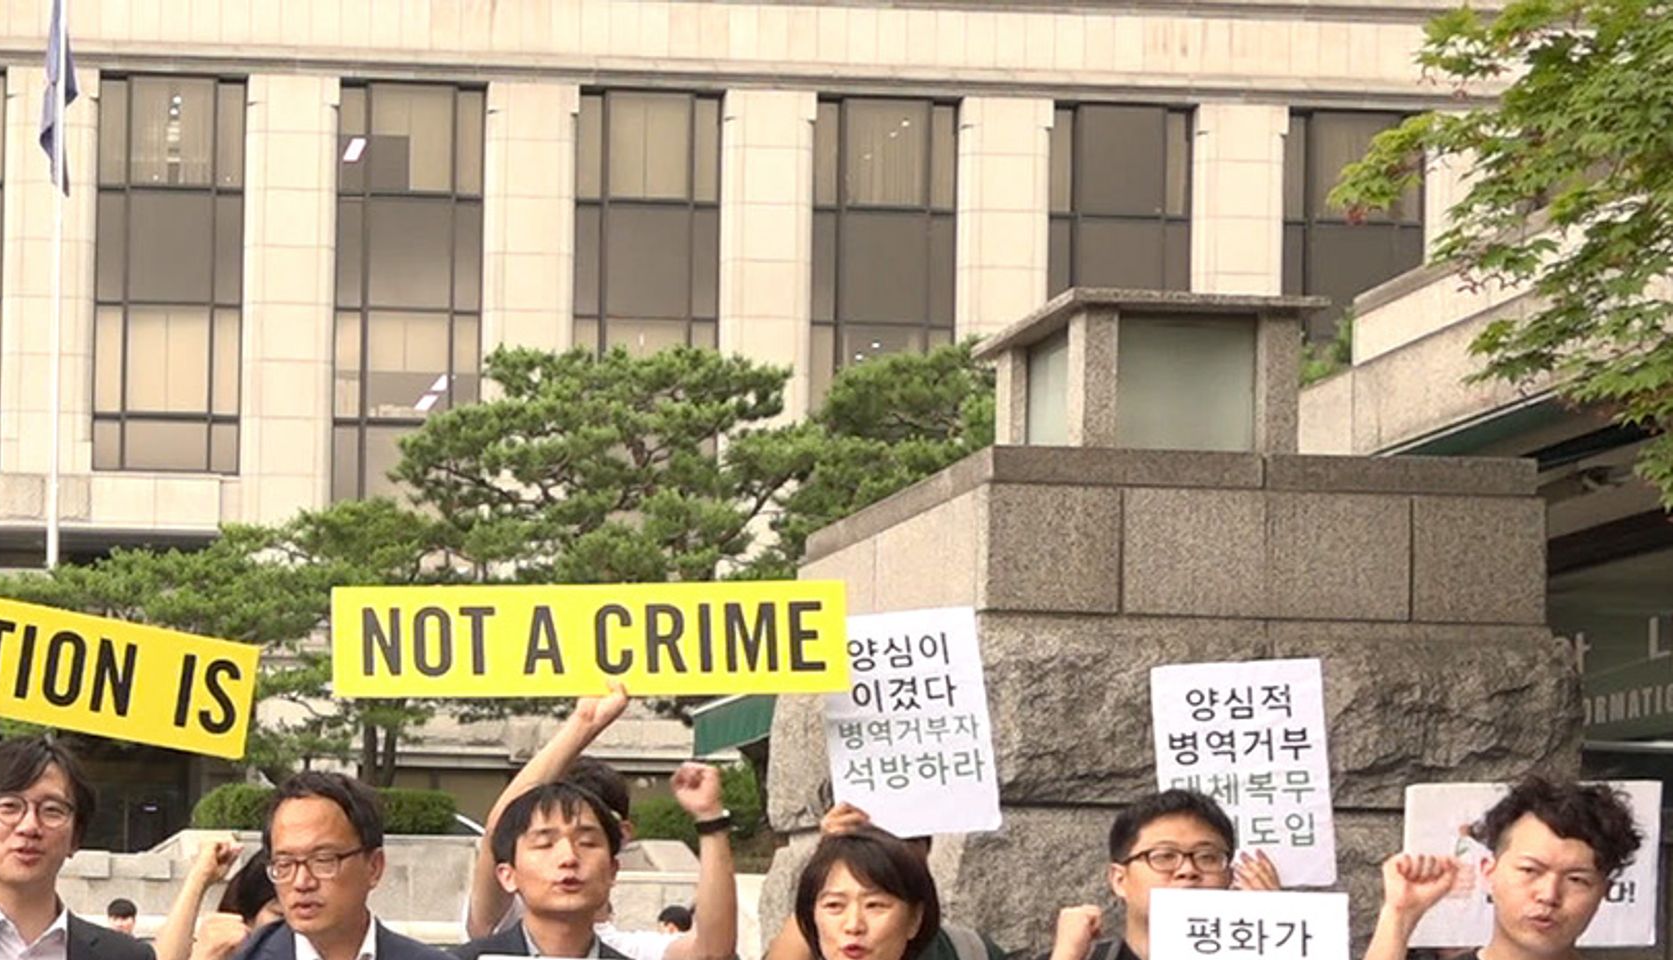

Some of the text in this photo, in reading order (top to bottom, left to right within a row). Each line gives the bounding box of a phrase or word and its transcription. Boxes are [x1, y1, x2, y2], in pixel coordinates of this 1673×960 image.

[362, 601, 826, 677] NOT A CRIME
[847, 632, 950, 672] 양심이
[174, 654, 241, 734] IS
[852, 674, 957, 713] 이겼다
[1185, 684, 1292, 721] 양심적
[838, 713, 980, 750] 병역거부자
[1168, 727, 1312, 765] 병역거부
[844, 749, 985, 791] 석방하라
[1186, 917, 1313, 957] 평화가
